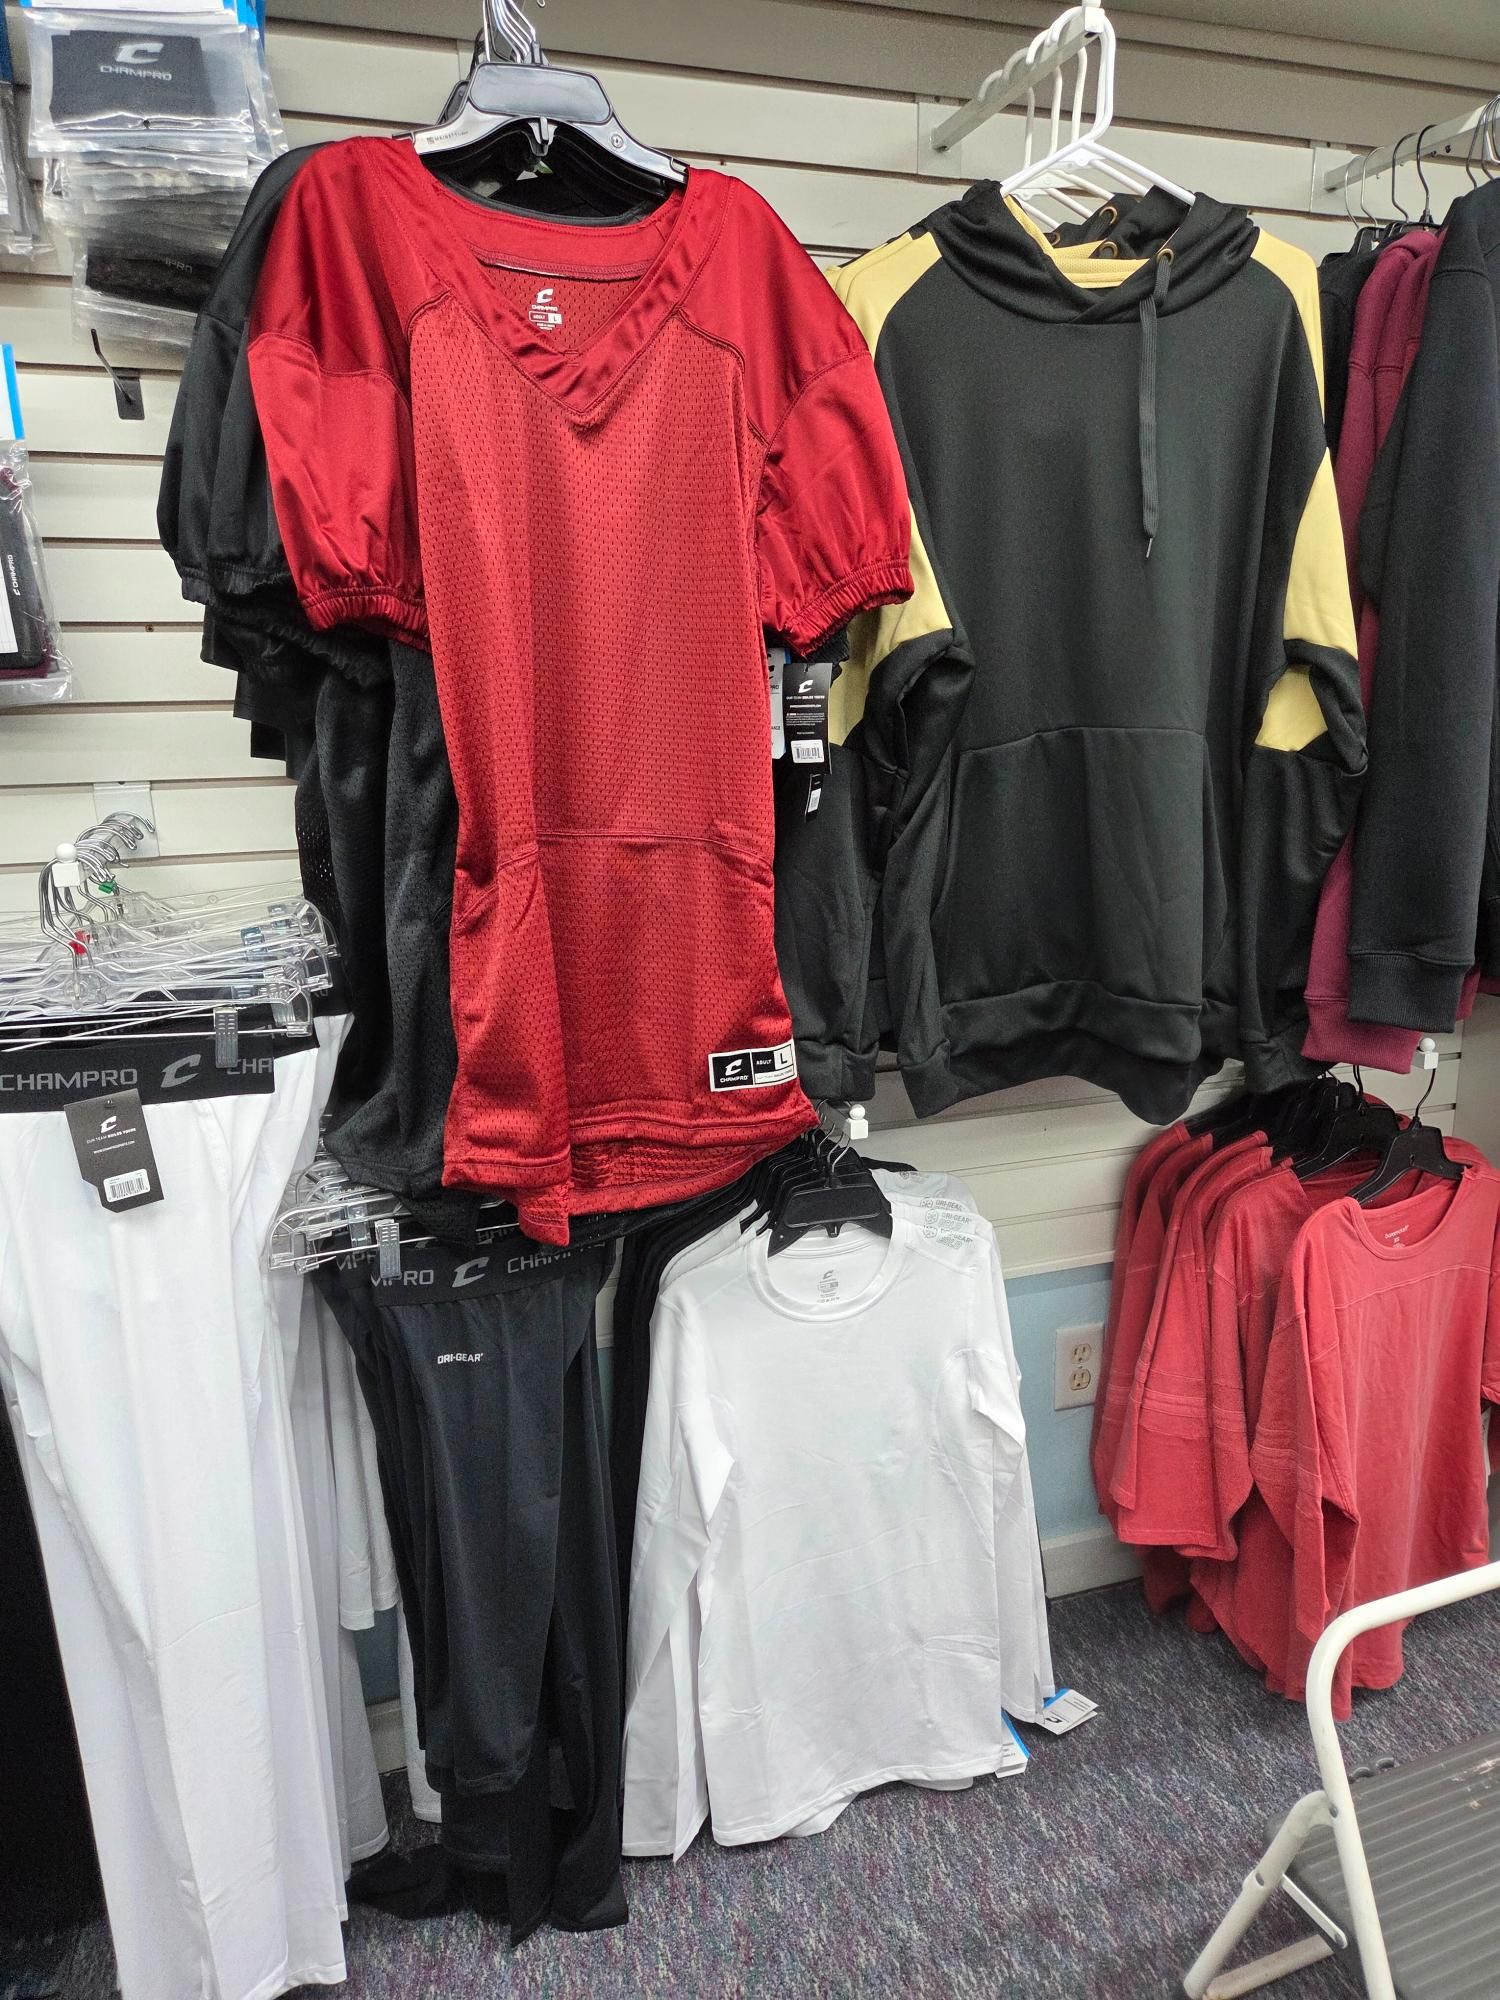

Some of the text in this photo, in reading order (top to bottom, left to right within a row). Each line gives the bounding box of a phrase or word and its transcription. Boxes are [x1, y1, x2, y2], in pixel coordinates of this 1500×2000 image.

[100, 65, 172, 81] CHAMPRO
[779, 1052, 788, 1064] L
[0, 1068, 138, 1091] CHAMPRO
[720, 1075, 749, 1083] CHAMPRO
